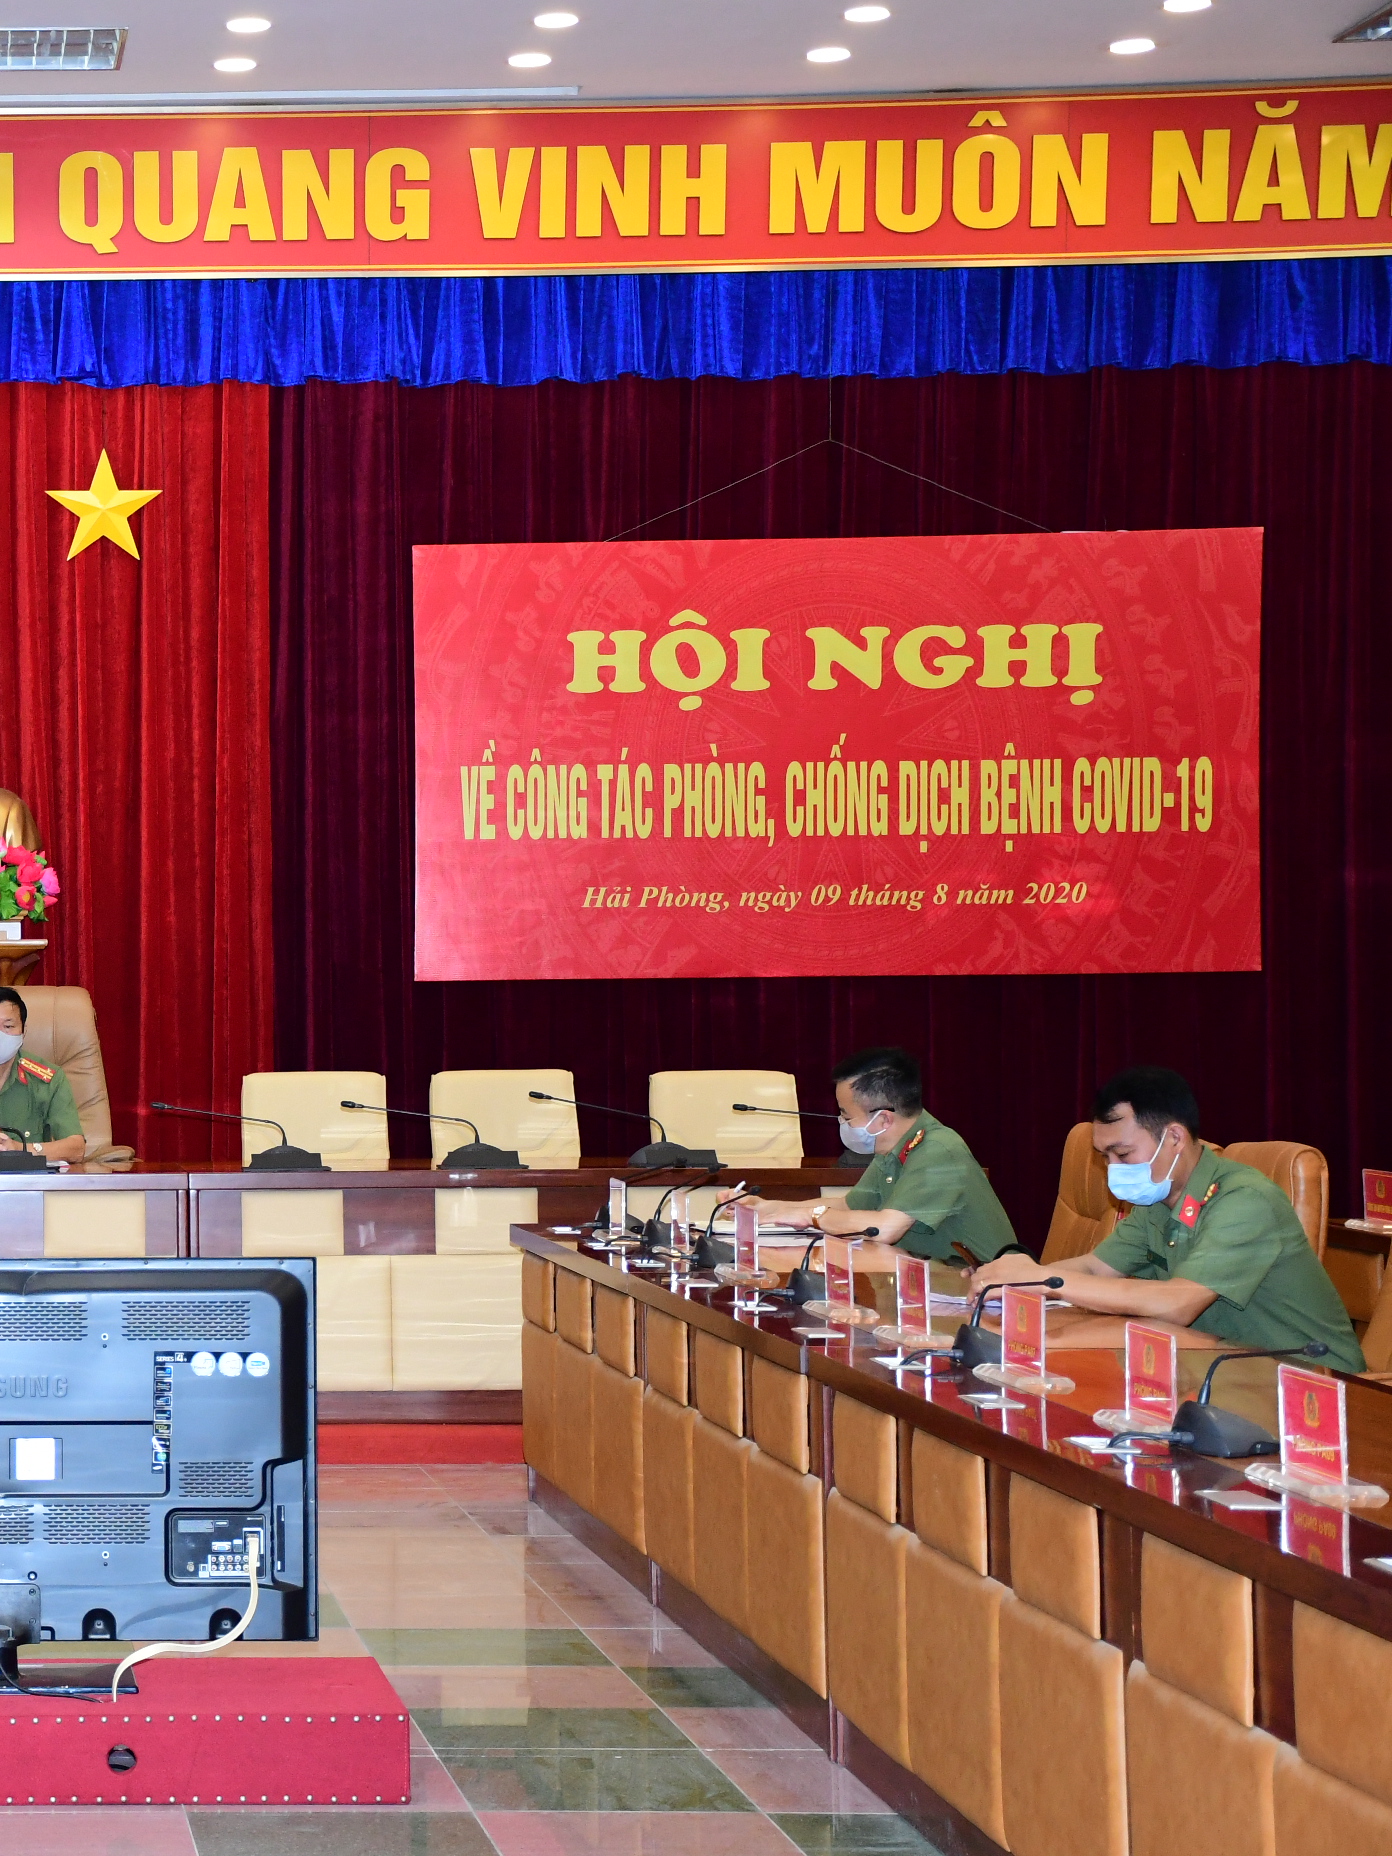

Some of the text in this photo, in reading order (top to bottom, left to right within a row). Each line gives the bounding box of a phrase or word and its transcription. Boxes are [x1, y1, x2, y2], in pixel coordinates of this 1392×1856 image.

[57, 146, 433, 256] QUANG
[468, 143, 729, 240] VINH
[767, 110, 1110, 235] MUÔN
[1149, 99, 1392, 225] NĂM
[565, 608, 1105, 713] HỘI NGHỊ
[460, 732, 1214, 853] VỀ CÔNG TÁC PHÒNG, CHỐNG DỊCH BỆNH COVID-19
[583, 881, 1088, 914] Hải Phòng, ngày 09 tháng 8 năm 2020
